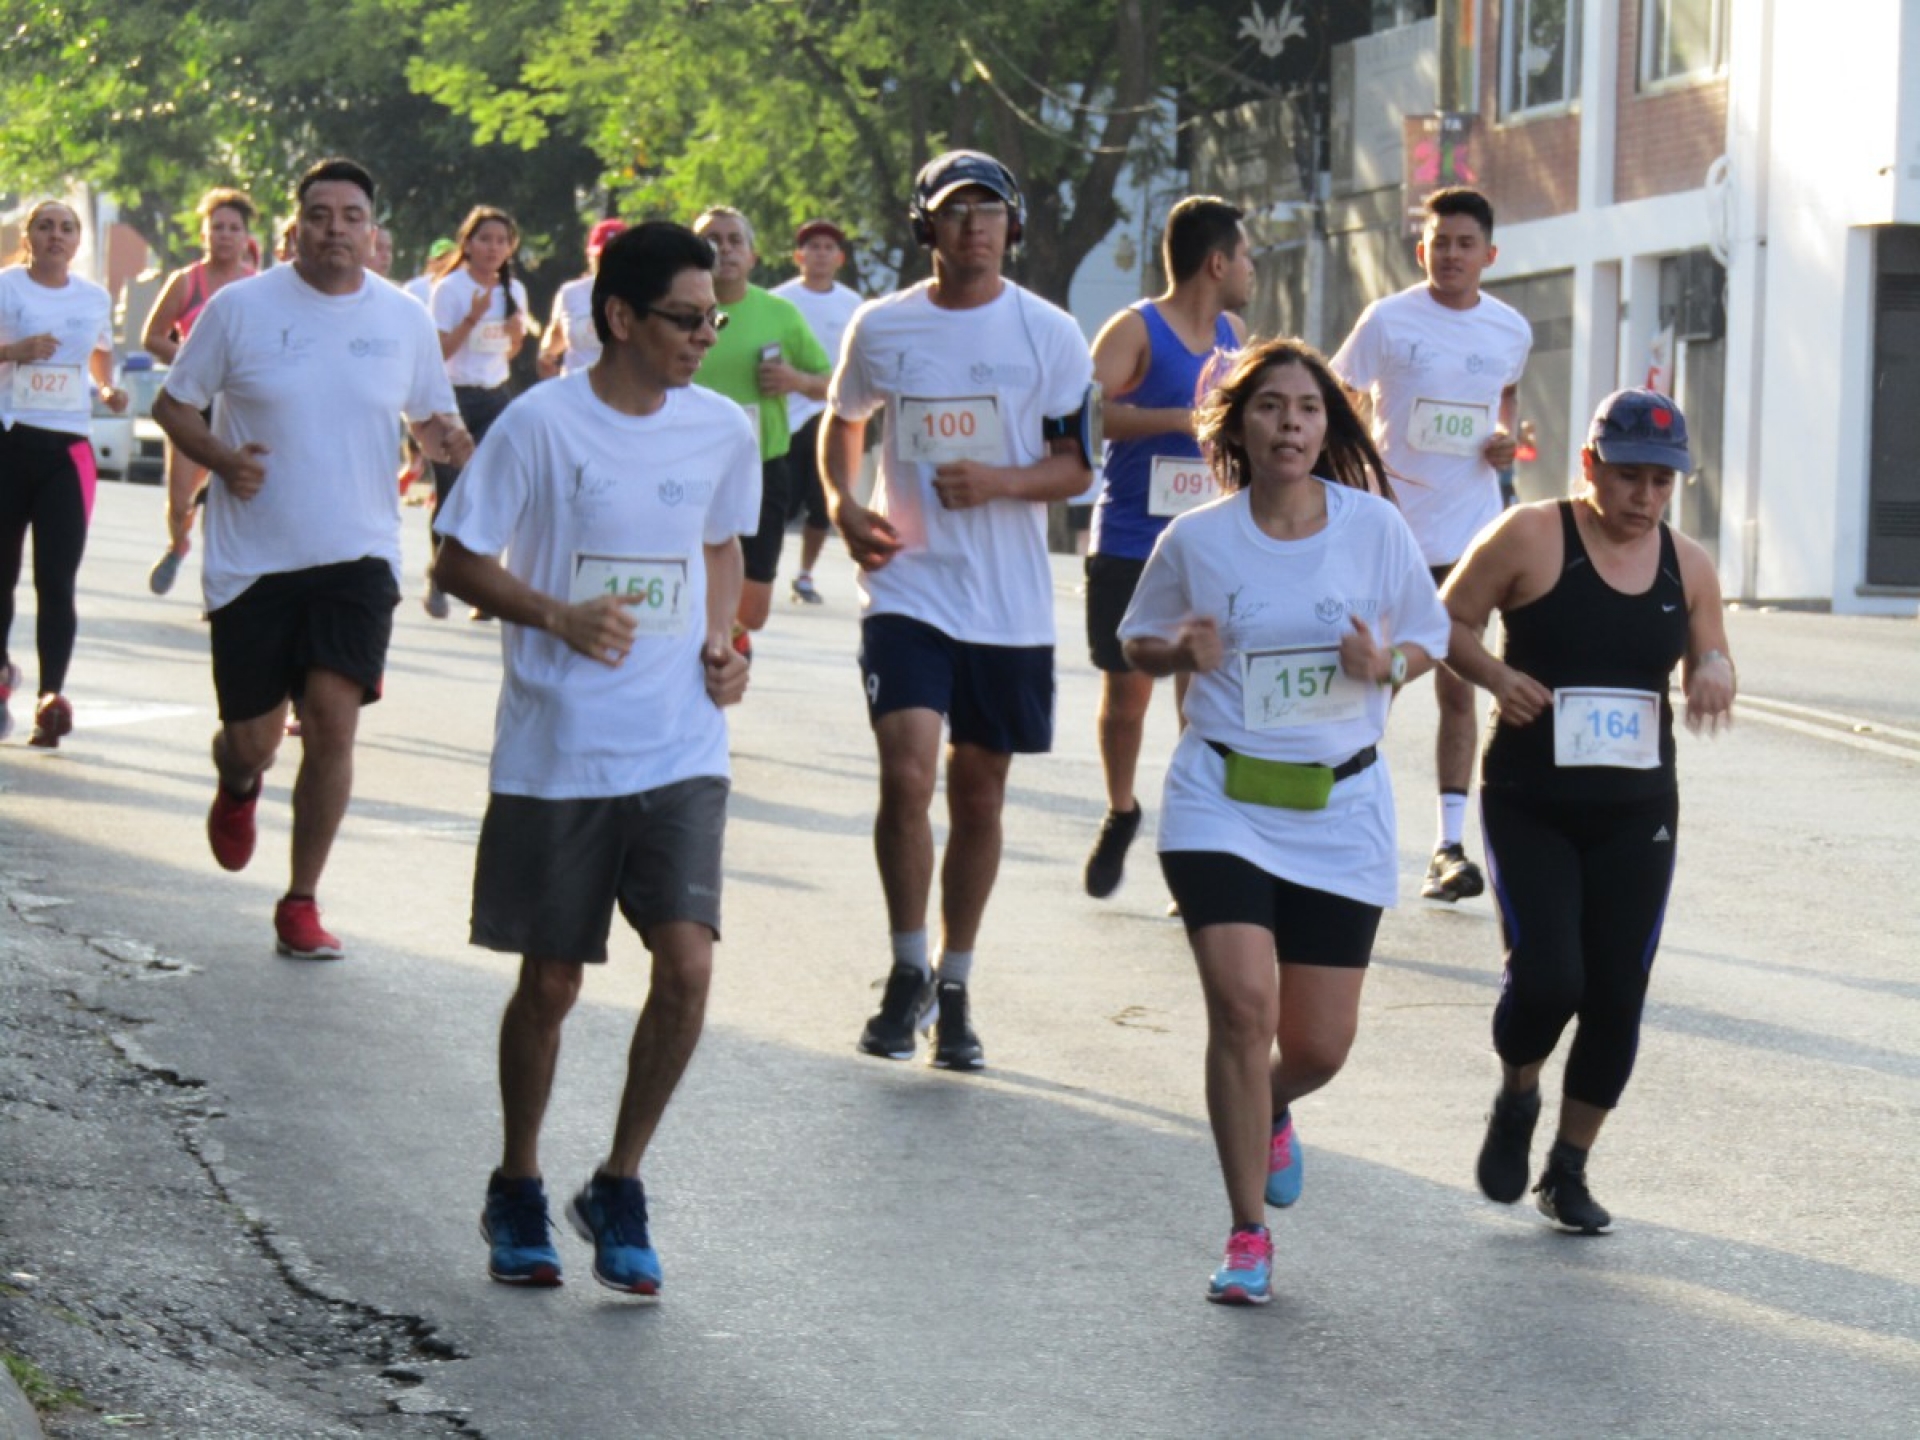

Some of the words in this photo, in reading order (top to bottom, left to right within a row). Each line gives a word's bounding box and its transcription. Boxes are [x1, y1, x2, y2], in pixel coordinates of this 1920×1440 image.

[31, 372, 68, 392] 027
[922, 410, 977, 438] 100
[1434, 413, 1474, 437] 108
[1173, 472, 1213, 495] 091
[604, 576, 665, 608] 156
[1276, 665, 1337, 698] 157
[1586, 709, 1639, 740] 164
